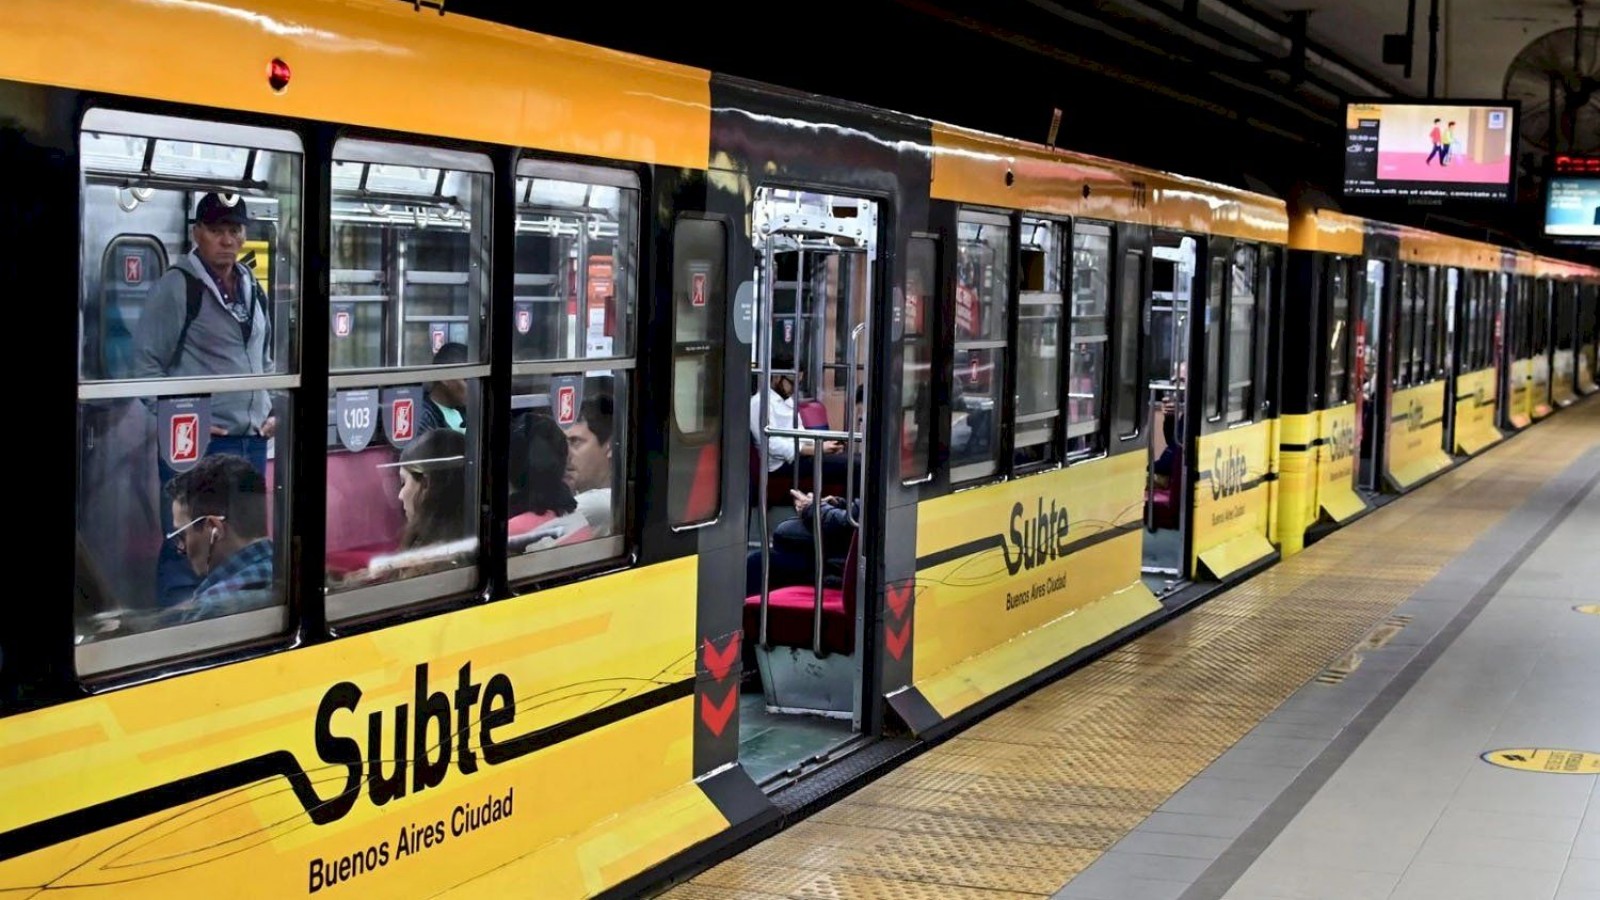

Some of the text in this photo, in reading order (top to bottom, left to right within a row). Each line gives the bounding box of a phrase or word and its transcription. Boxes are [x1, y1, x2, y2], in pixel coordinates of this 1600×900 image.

[350, 407, 370, 429] 103
[1213, 445, 1247, 501] Subte
[1008, 496, 1069, 576] Subte
[1006, 572, 1067, 612] Buenos Aires Ciudad
[311, 660, 516, 825] Subte
[308, 786, 514, 895] Buenos Aires Ciudad
